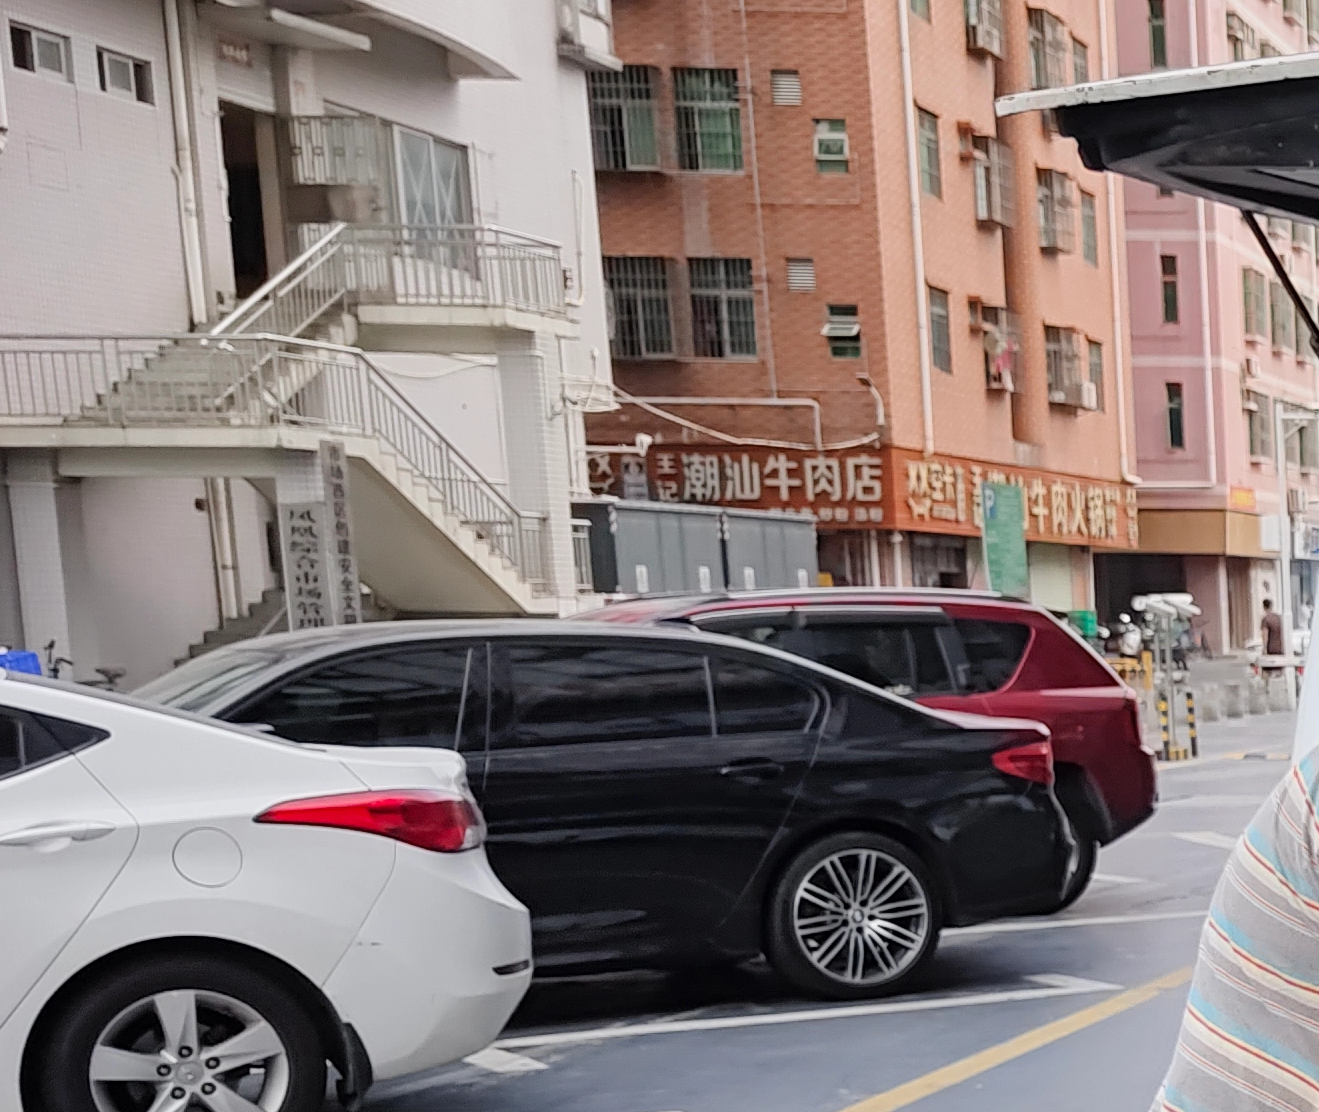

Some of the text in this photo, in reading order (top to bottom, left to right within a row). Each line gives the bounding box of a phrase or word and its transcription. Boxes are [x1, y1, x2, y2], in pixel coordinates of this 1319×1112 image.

[682, 453, 883, 502] 潮汕牛肉店
